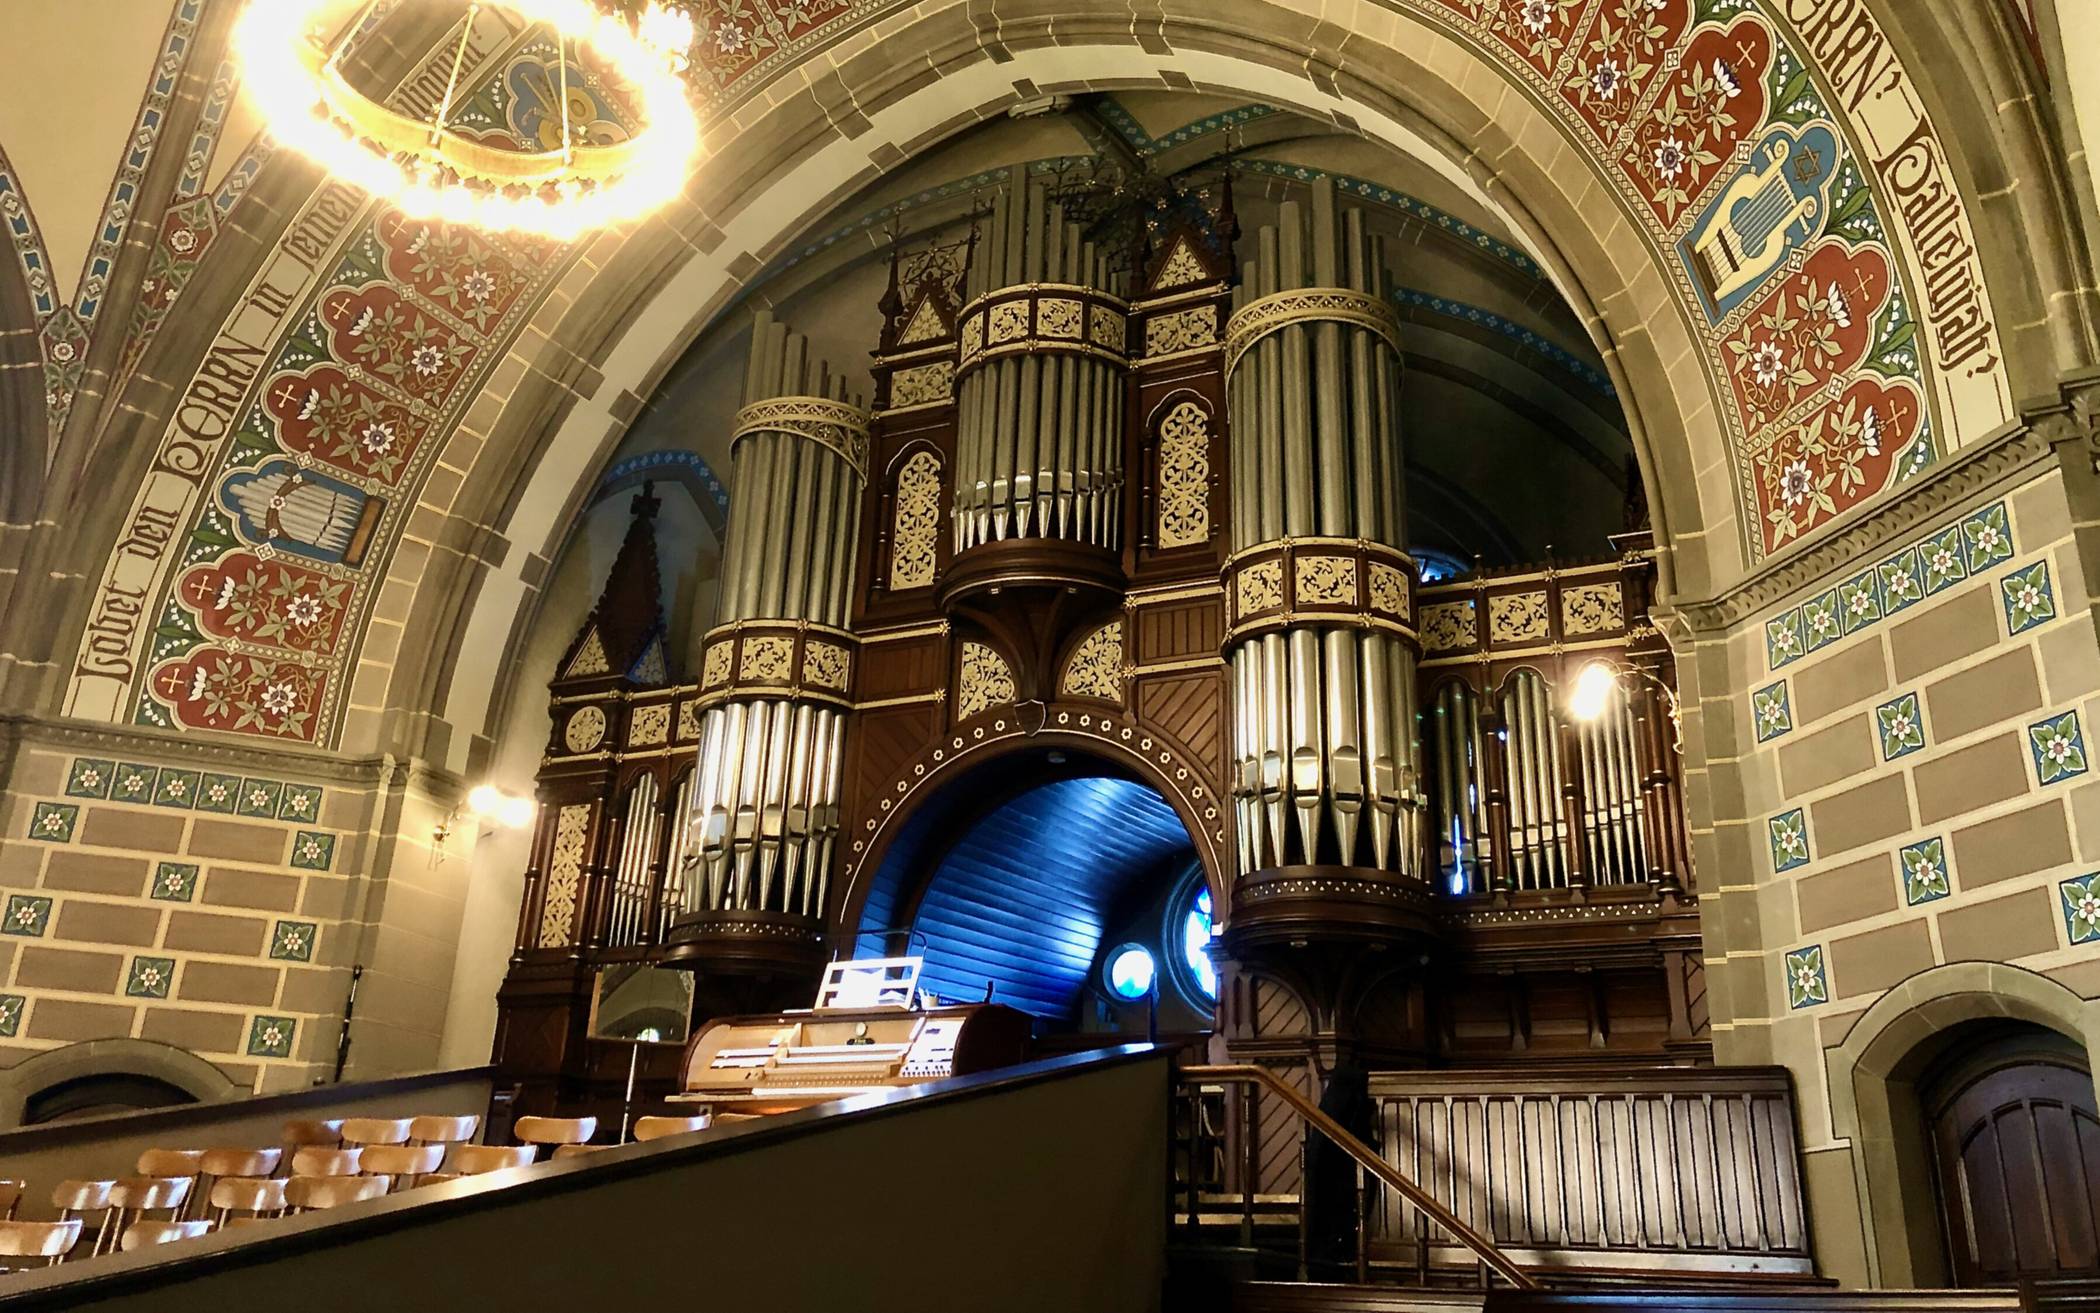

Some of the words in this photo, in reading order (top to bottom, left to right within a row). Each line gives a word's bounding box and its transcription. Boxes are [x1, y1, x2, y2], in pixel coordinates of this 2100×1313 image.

[1873, 113, 1998, 378] Hallelujah!
[75, 579, 147, 684] Lobet
[117, 506, 180, 560] den
[151, 330, 267, 490] HERRN
[244, 282, 293, 318] in
